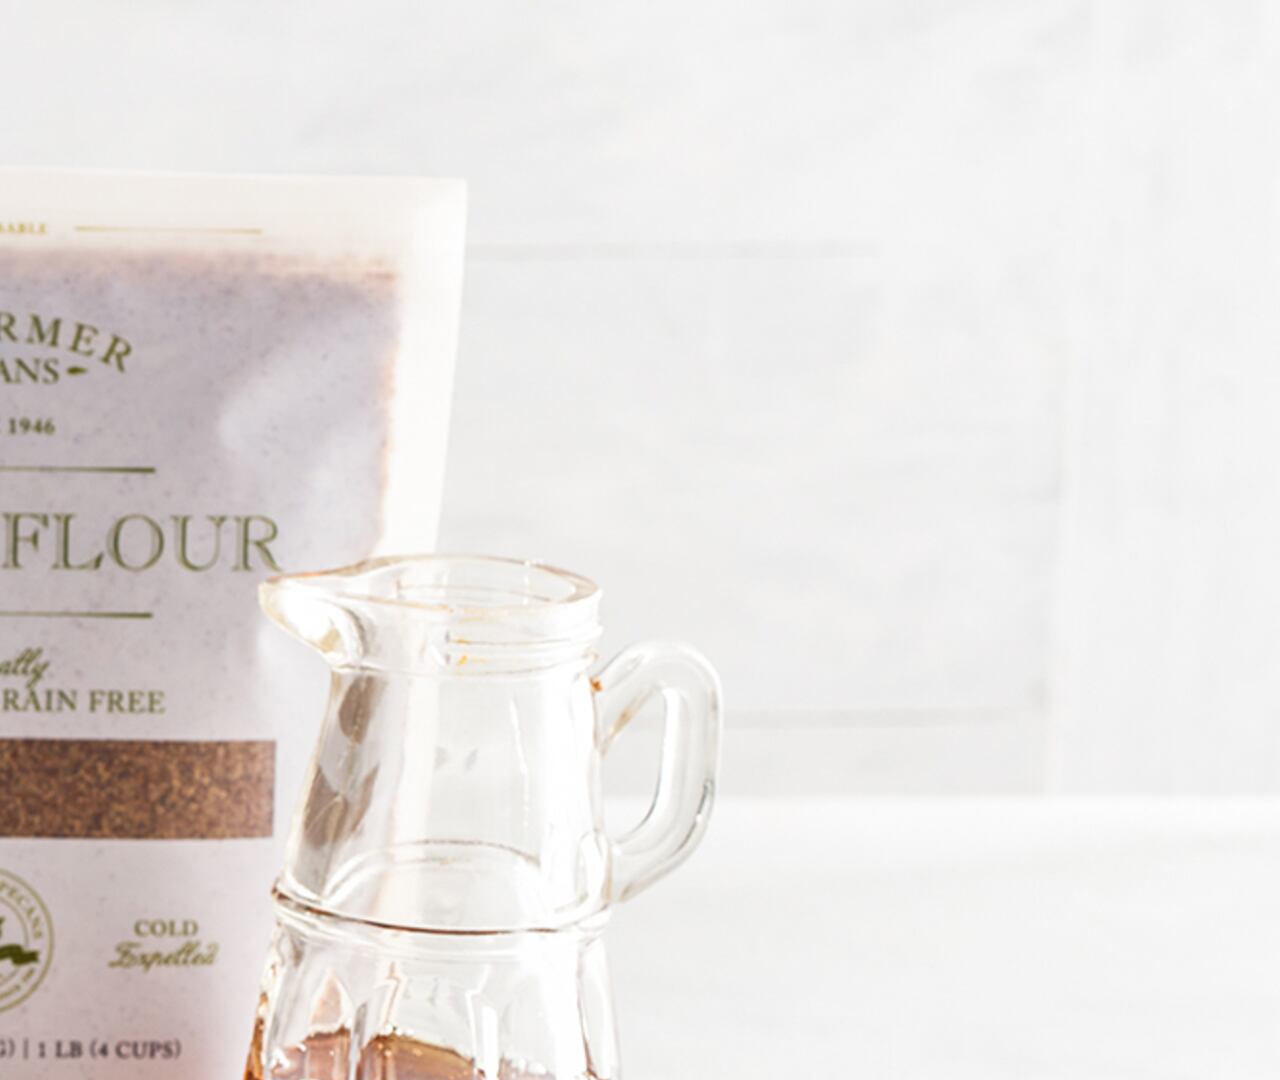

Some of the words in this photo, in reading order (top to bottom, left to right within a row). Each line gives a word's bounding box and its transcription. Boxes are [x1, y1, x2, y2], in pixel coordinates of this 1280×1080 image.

[7, 416, 56, 436] 1946
[0, 511, 286, 572] FLOUR
[88, 688, 167, 715] FREE
[132, 918, 201, 940] COLD
[106, 941, 221, 972] Expelled
[37, 1040, 47, 1059] 1
[54, 1038, 85, 1060] LB
[89, 1037, 110, 1061] (4
[113, 1037, 183, 1061] CUPS)
